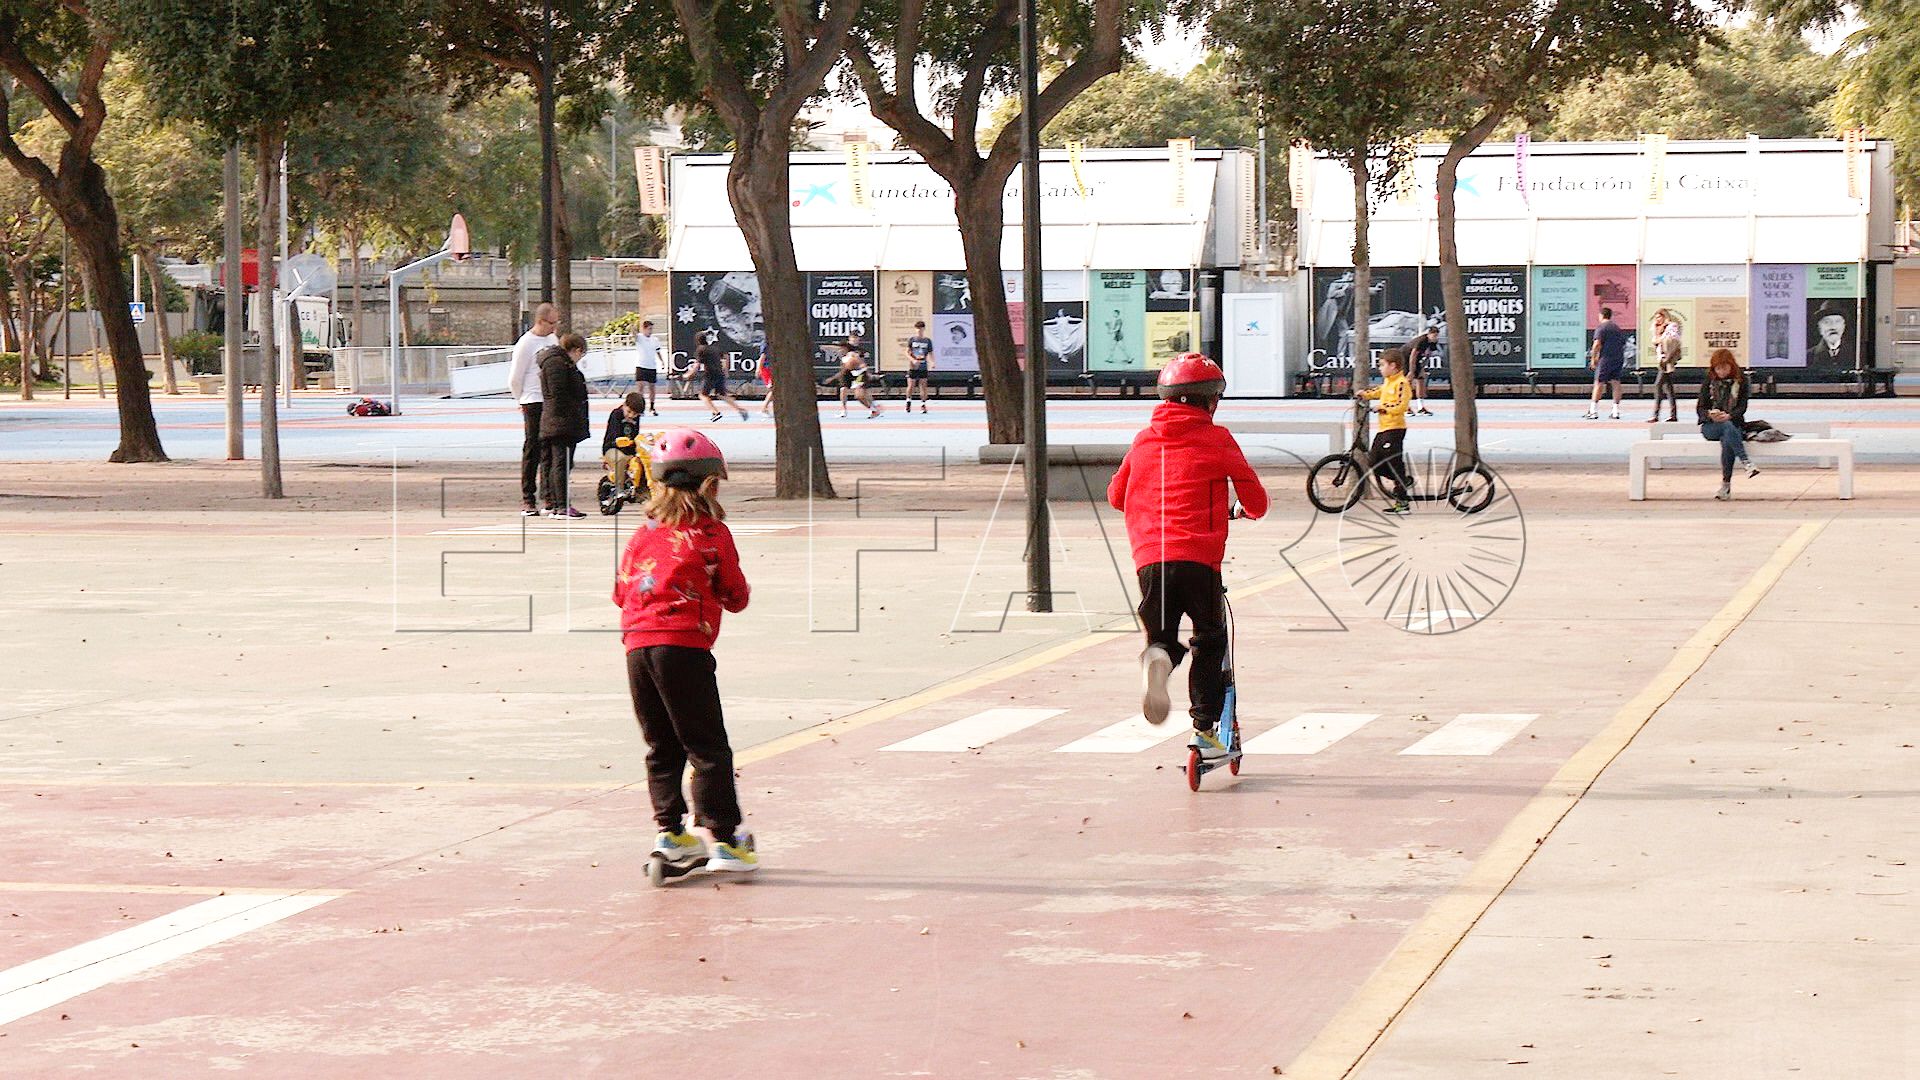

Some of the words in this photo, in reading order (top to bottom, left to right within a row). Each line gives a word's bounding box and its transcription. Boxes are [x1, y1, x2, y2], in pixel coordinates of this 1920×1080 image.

[817, 288, 868, 296] ESPECTÁCULO
[811, 303, 873, 319] GEORGES
[1538, 302, 1580, 312] WELCOME
[819, 319, 866, 337] MÉLIÈS
[1467, 315, 1516, 333] MÉLIÈS
[1472, 340, 1512, 356] 1900
